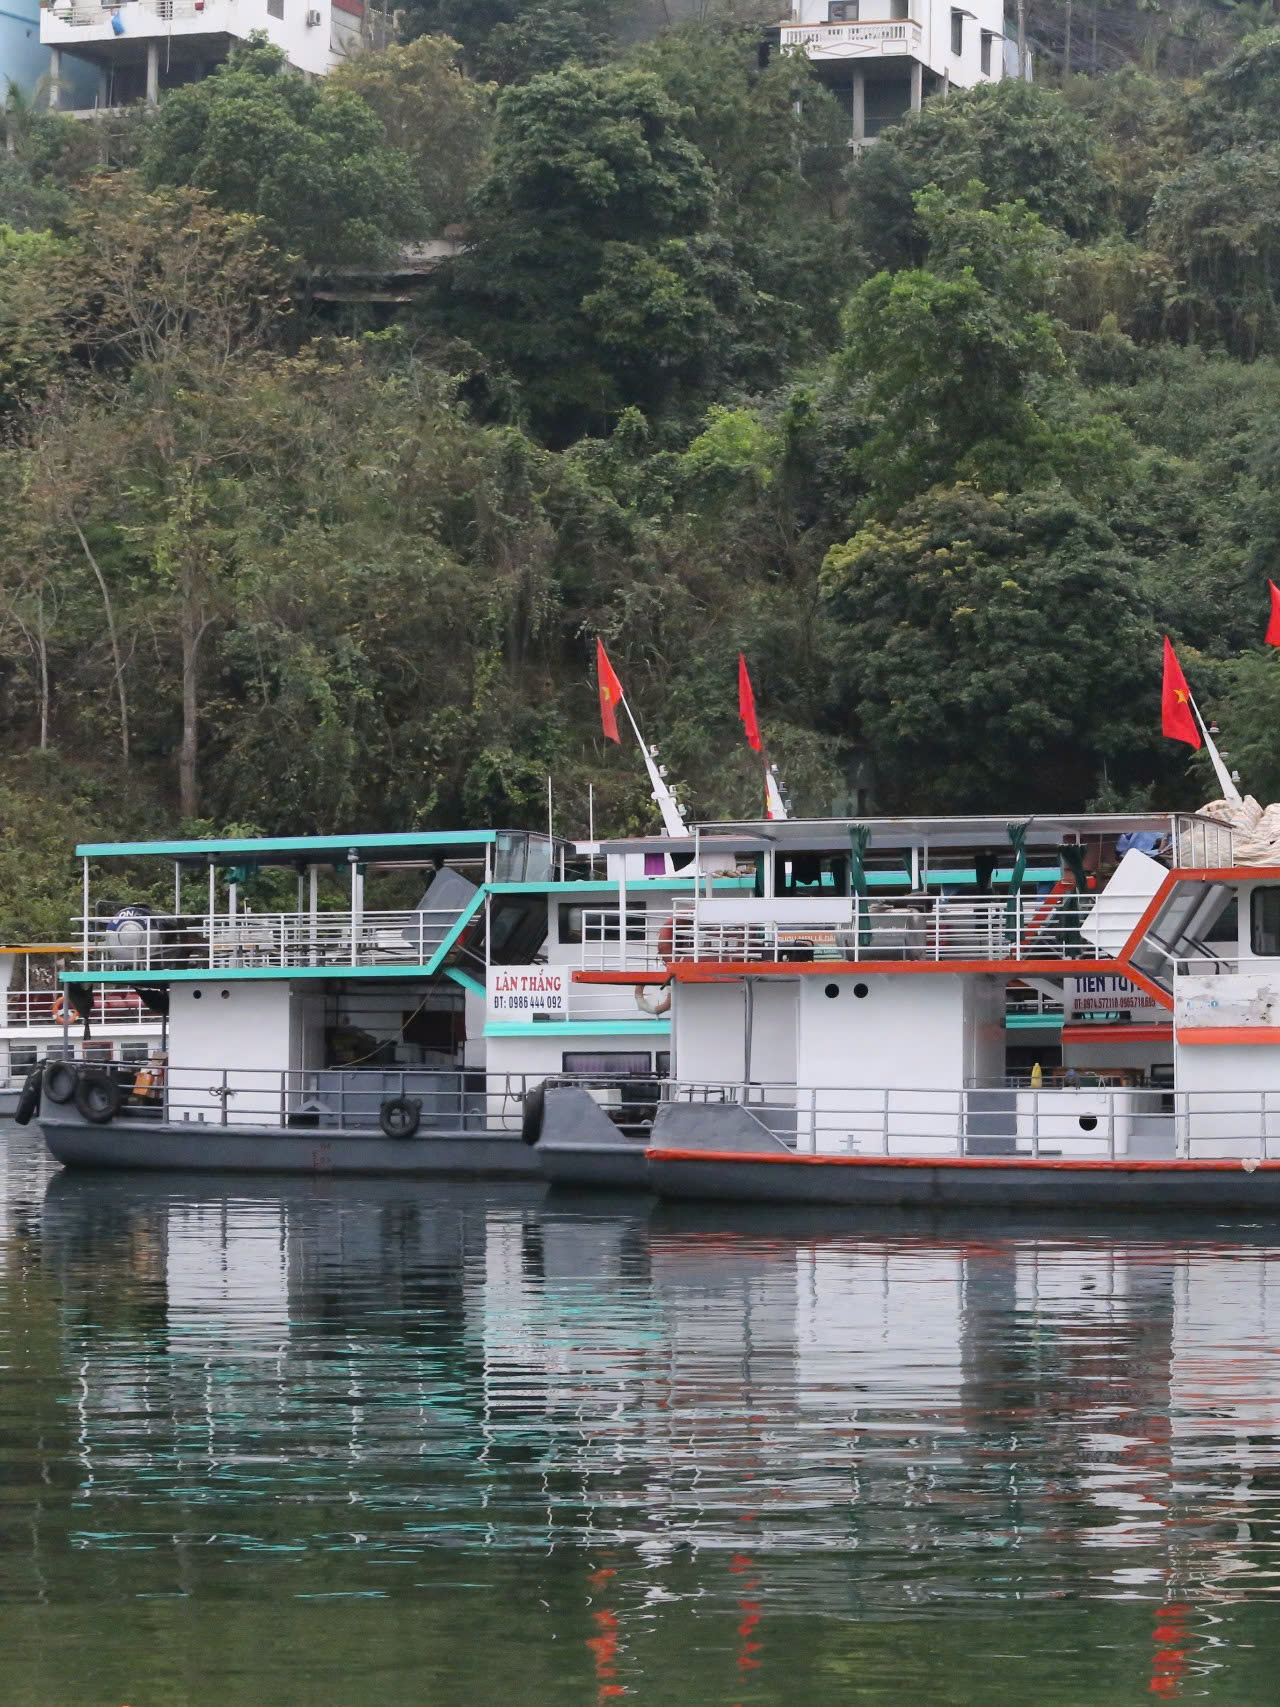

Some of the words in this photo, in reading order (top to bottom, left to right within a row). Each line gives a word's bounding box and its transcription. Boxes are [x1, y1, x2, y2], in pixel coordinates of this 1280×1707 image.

[495, 971, 518, 992] LÂN
[520, 968, 562, 992] THẮNG
[508, 995, 528, 1009] 0986
[529, 995, 545, 1009] 444
[546, 995, 562, 1009] 092
